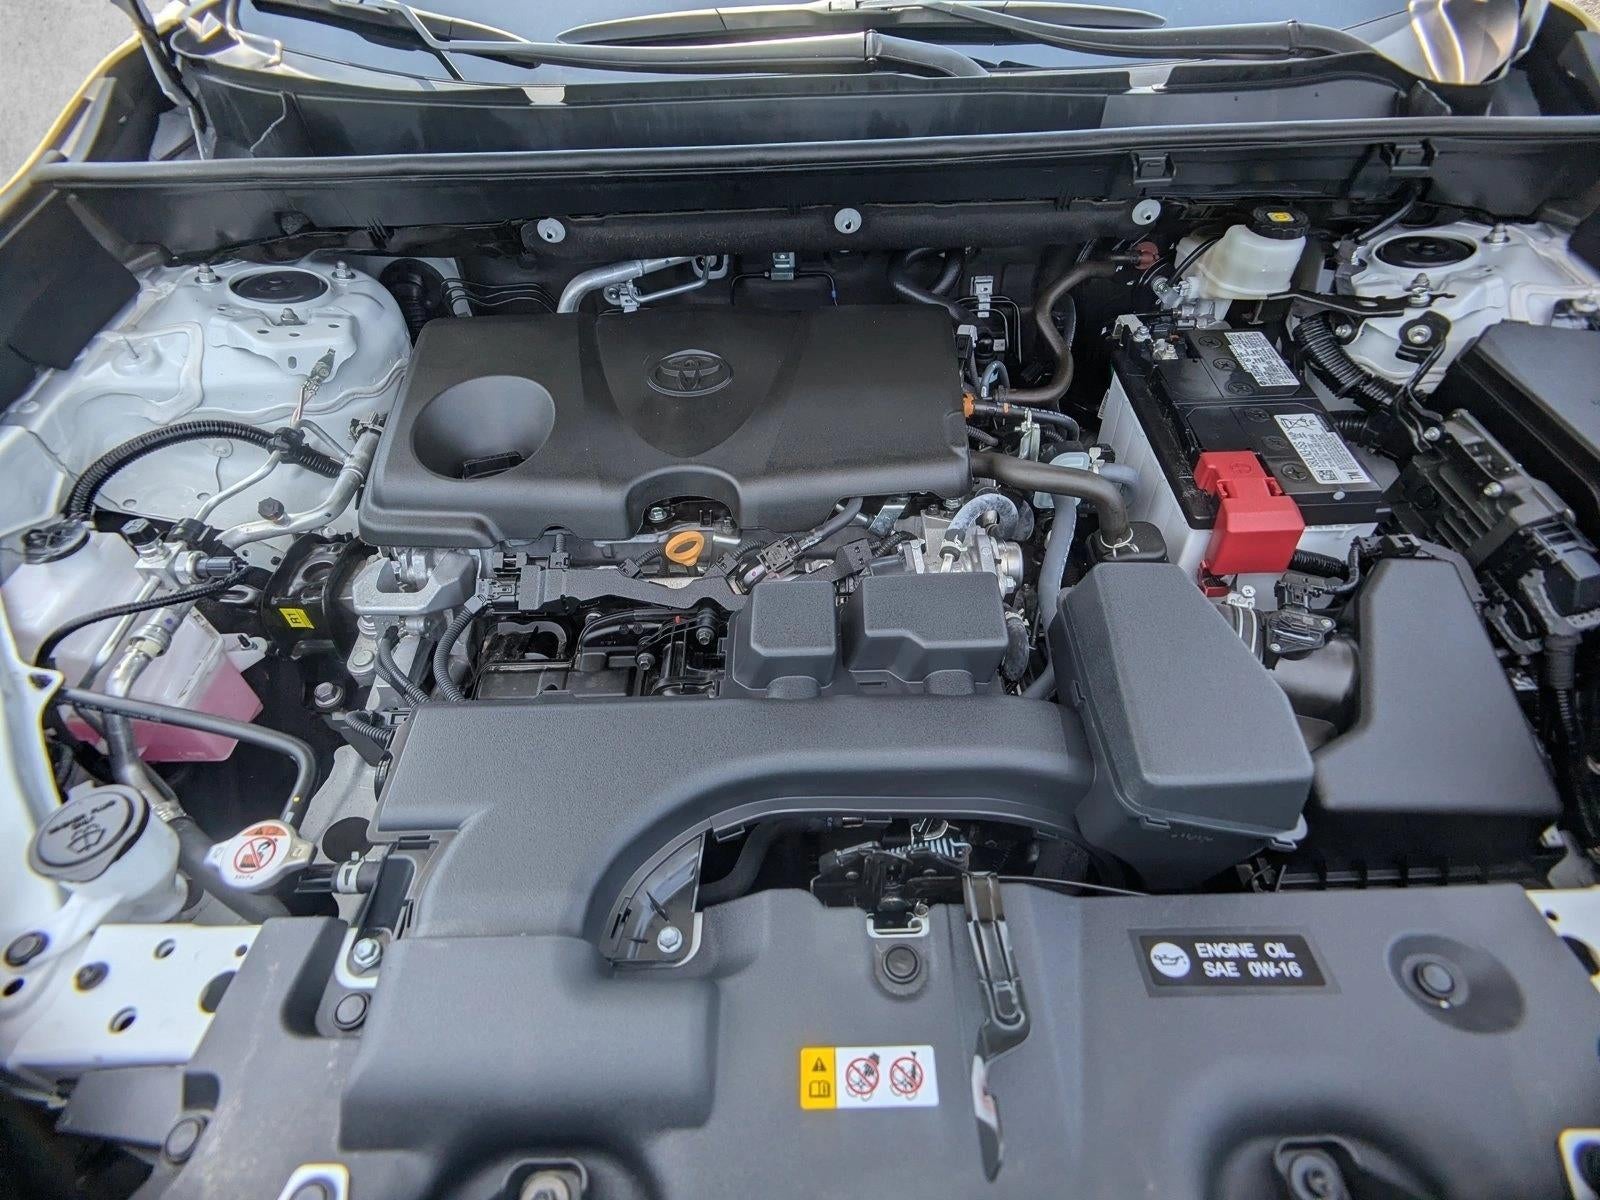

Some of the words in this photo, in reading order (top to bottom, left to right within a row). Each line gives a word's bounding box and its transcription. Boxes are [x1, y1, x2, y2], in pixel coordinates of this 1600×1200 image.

[1194, 942, 1258, 958] ENGINE
[1263, 942, 1296, 958] OIL
[1202, 961, 1240, 978] SAE
[1247, 961, 1303, 978] 0W-16
